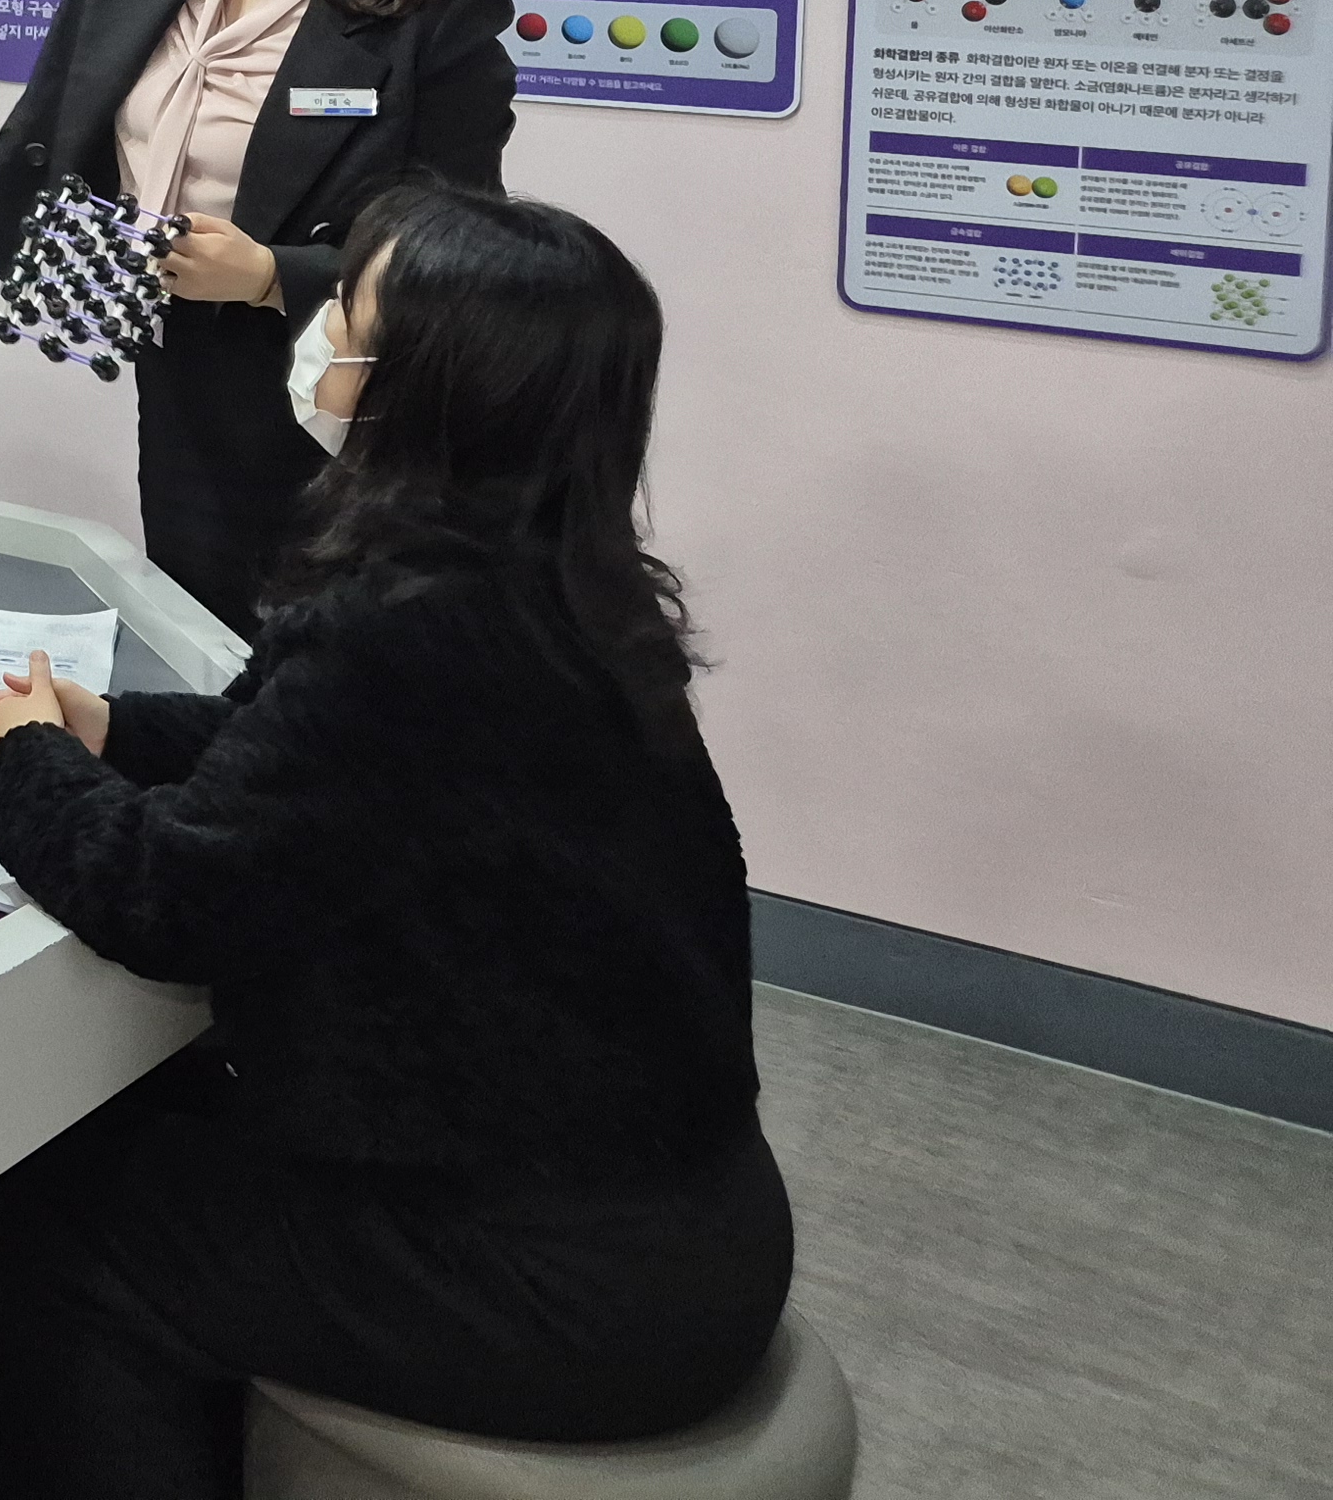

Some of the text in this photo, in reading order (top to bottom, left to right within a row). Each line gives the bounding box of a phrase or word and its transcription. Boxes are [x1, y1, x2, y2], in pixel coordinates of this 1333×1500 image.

[873, 47, 933, 62] 화학결합의
[935, 51, 960, 64] 종류
[966, 53, 1041, 69] 화학결합이란
[1042, 57, 1070, 70] 원자
[1071, 59, 1097, 73] 또는
[1100, 61, 1138, 75] 이온을
[1141, 62, 1181, 77] 연결해
[1183, 65, 1211, 79] 분자
[1213, 67, 1241, 81] 또는
[872, 67, 932, 82] 형성시키는
[934, 71, 959, 84] 원자
[962, 72, 986, 85] 간의
[990, 74, 1026, 88] 결합을
[1029, 76, 1070, 91] 말한다.
[1188, 87, 1241, 101] 분자라고
[912, 89, 973, 105] 공유결합에
[976, 93, 1001, 107] 의해
[1004, 95, 1041, 110] 형성된
[1097, 101, 1136, 116] 아니기
[1139, 104, 1178, 119] 때문에
[1182, 107, 1222, 122] 분자가
[1224, 110, 1265, 125] 아니라
